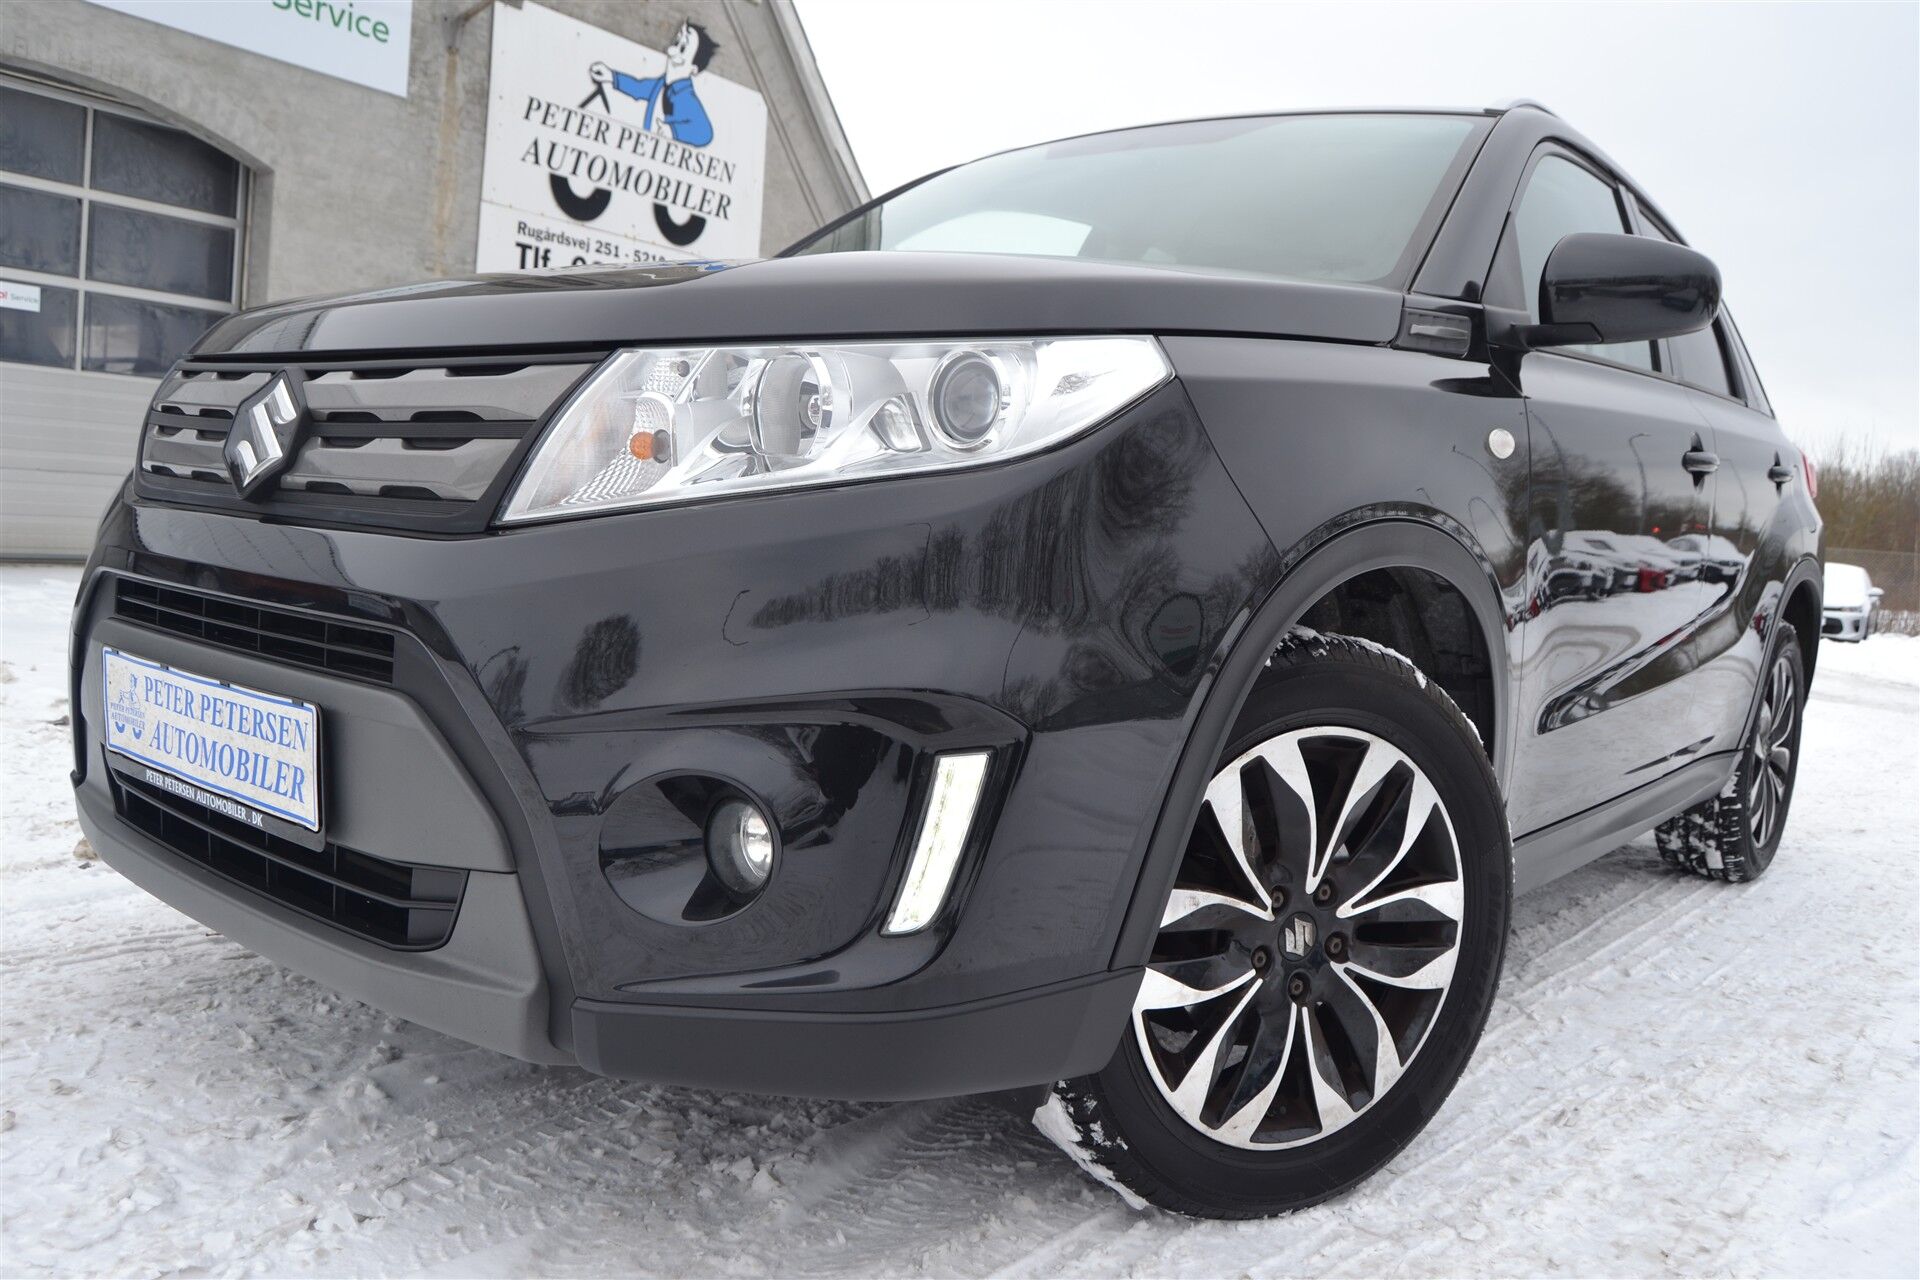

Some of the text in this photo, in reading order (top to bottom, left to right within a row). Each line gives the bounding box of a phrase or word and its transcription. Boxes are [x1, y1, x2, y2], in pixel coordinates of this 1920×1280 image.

[521, 137, 731, 220] AUTOMOBILER
[523, 95, 736, 184] PETER PETERSEN
[517, 221, 590, 253] Rugårdsvej
[595, 240, 620, 258] 251
[144, 675, 308, 753] PETER PETERSEN
[146, 769, 164, 787] PETER
[165, 777, 195, 800] PETERSEN
[196, 791, 247, 820] AUTOMOBILER
[149, 720, 305, 804] AUTOMOBILER
